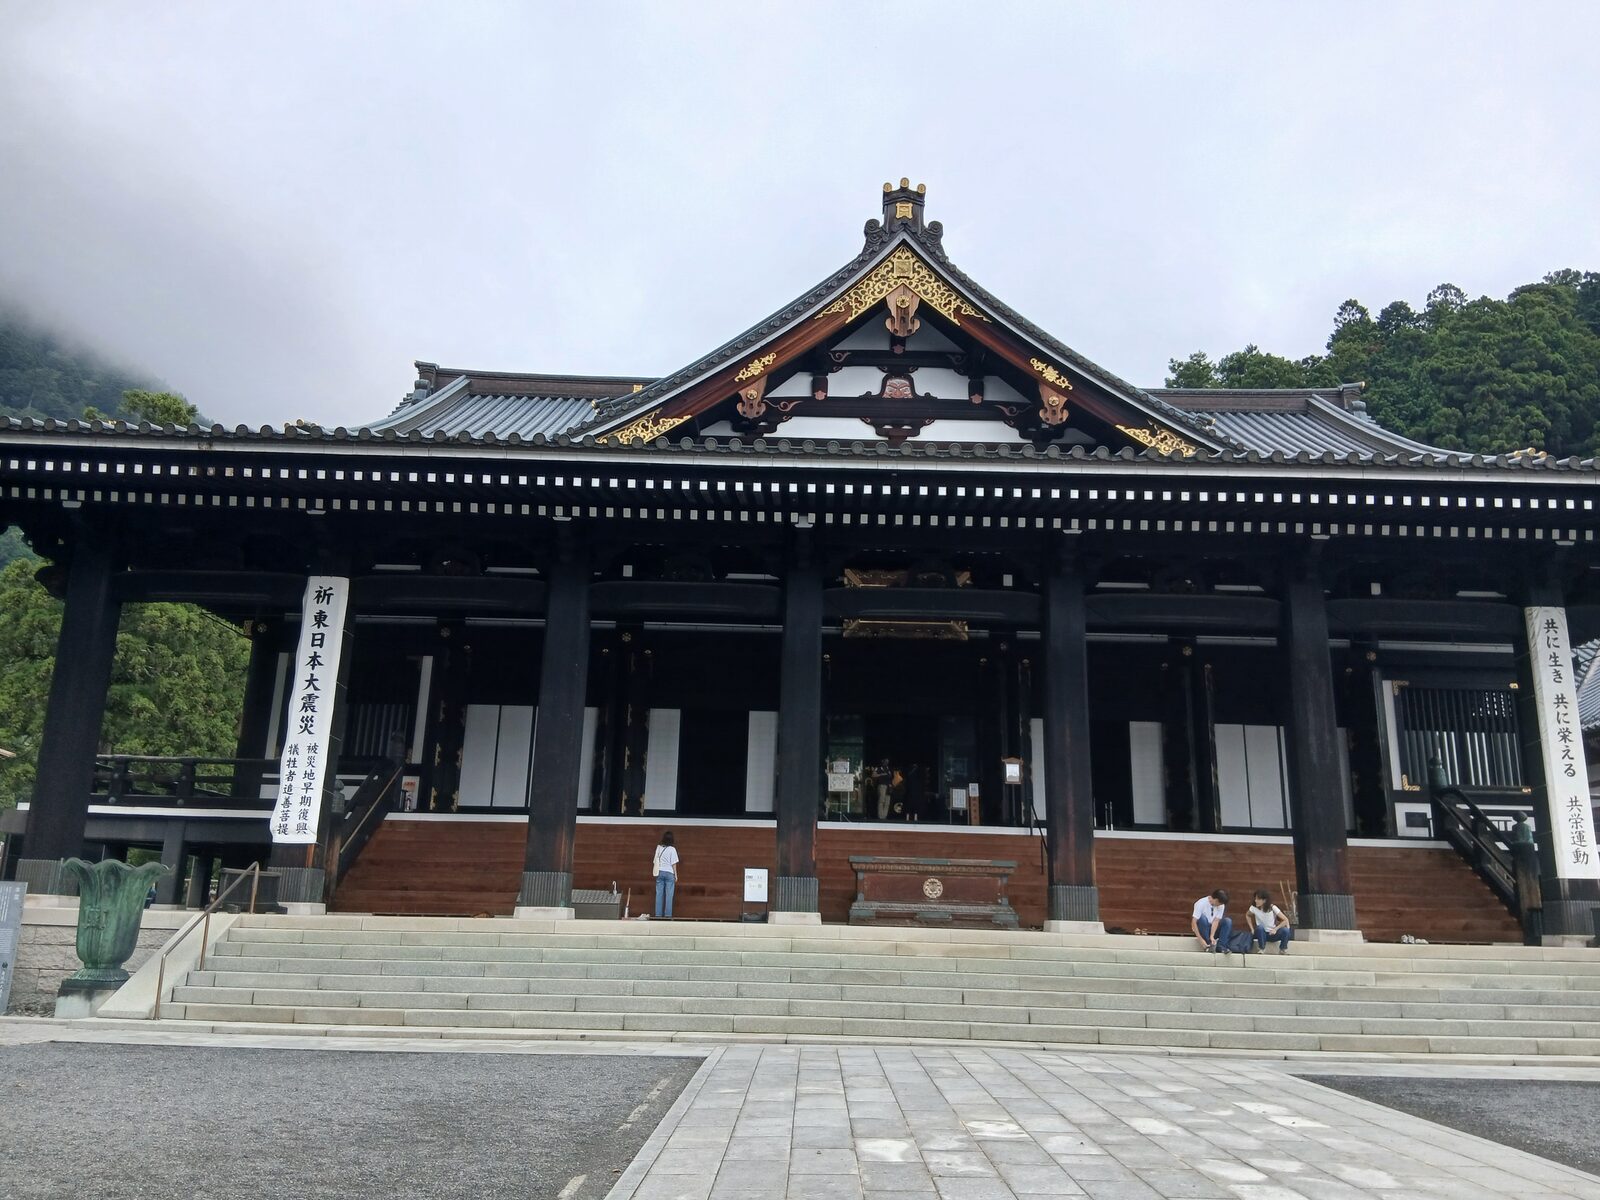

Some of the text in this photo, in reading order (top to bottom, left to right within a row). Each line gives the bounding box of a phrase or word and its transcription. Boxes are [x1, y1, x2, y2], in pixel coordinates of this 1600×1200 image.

[297, 585, 335, 735] 祈東日本大震災
[295, 742, 319, 835] 被災地早期復興
[1543, 618, 1590, 865] 共に生き 共に栄える 共栄運動
